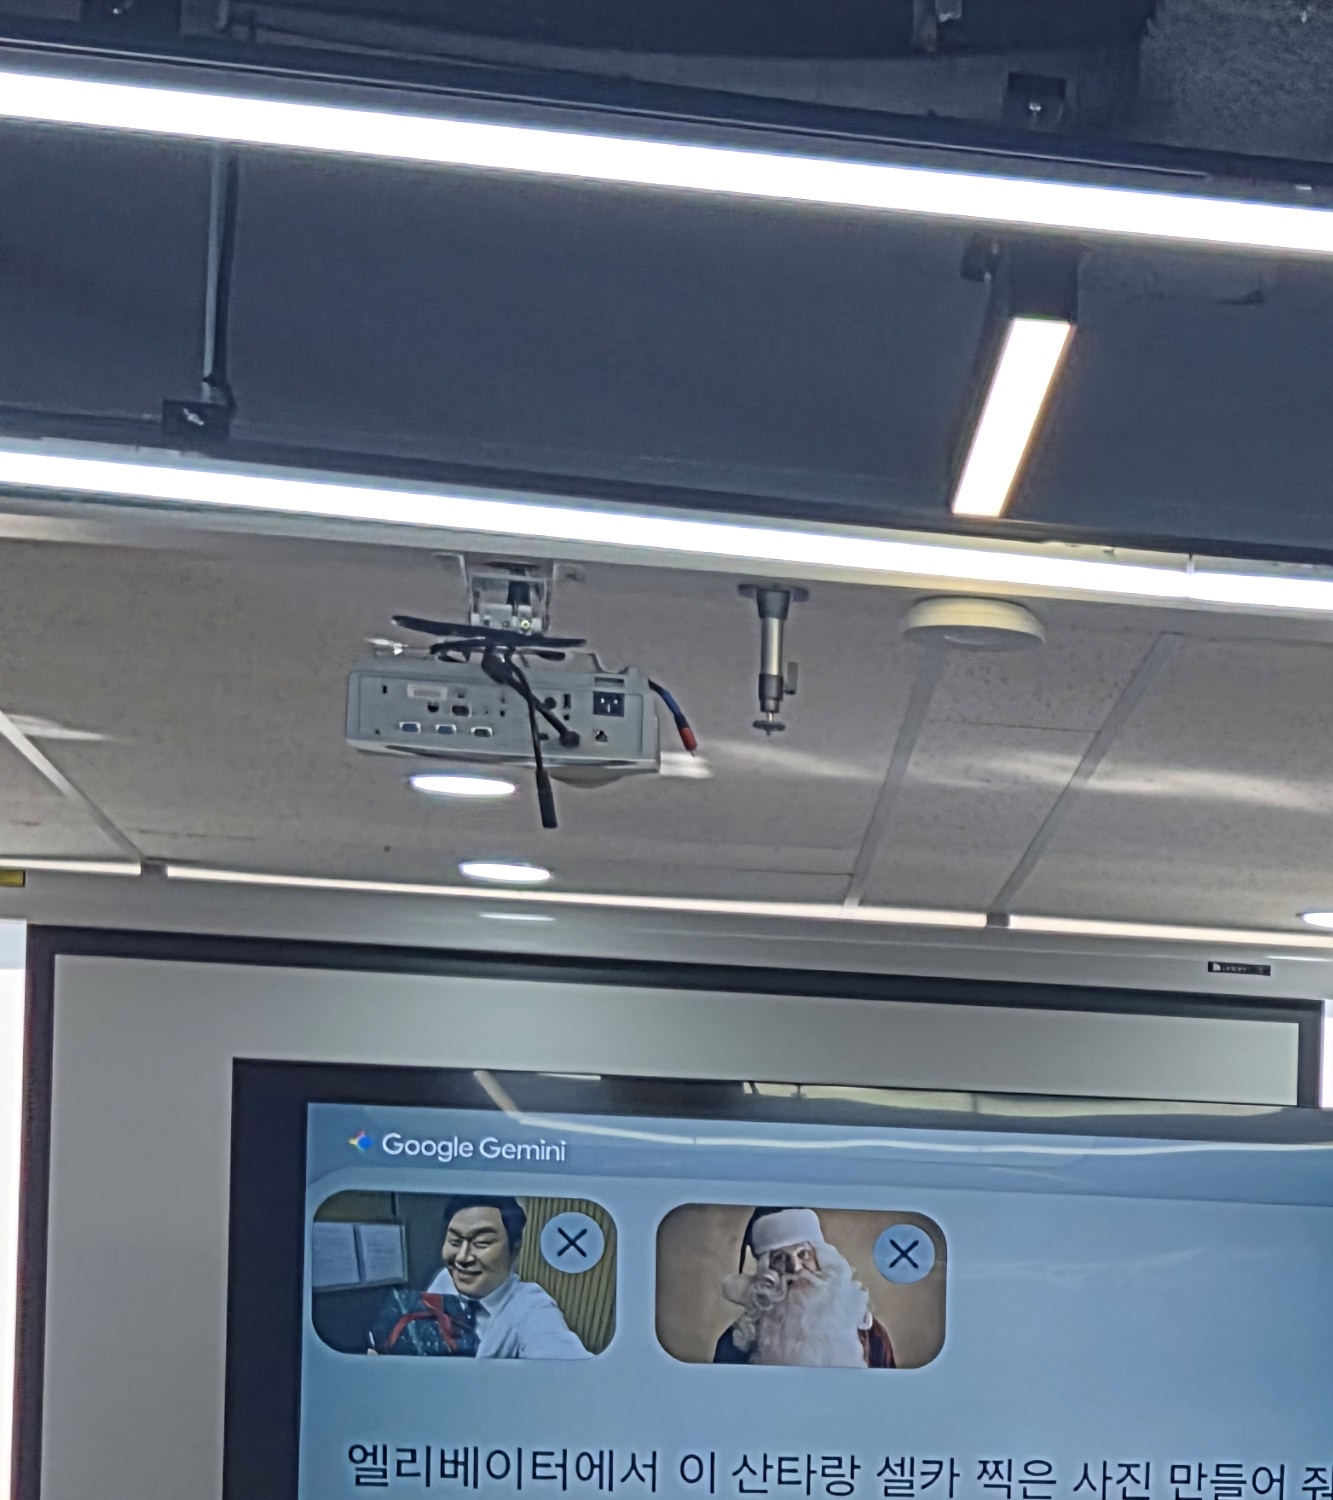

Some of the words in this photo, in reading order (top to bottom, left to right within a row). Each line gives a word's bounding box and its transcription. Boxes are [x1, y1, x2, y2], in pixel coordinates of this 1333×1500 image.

[382, 1133, 474, 1163] Google
[479, 1136, 567, 1162] Gemini
[347, 1444, 658, 1493] 엘리베이터에서
[679, 1451, 716, 1494] 이
[731, 1452, 862, 1497] 산타랑
[876, 1456, 961, 1499] 셀카
[976, 1458, 1058, 1500] 찍은
